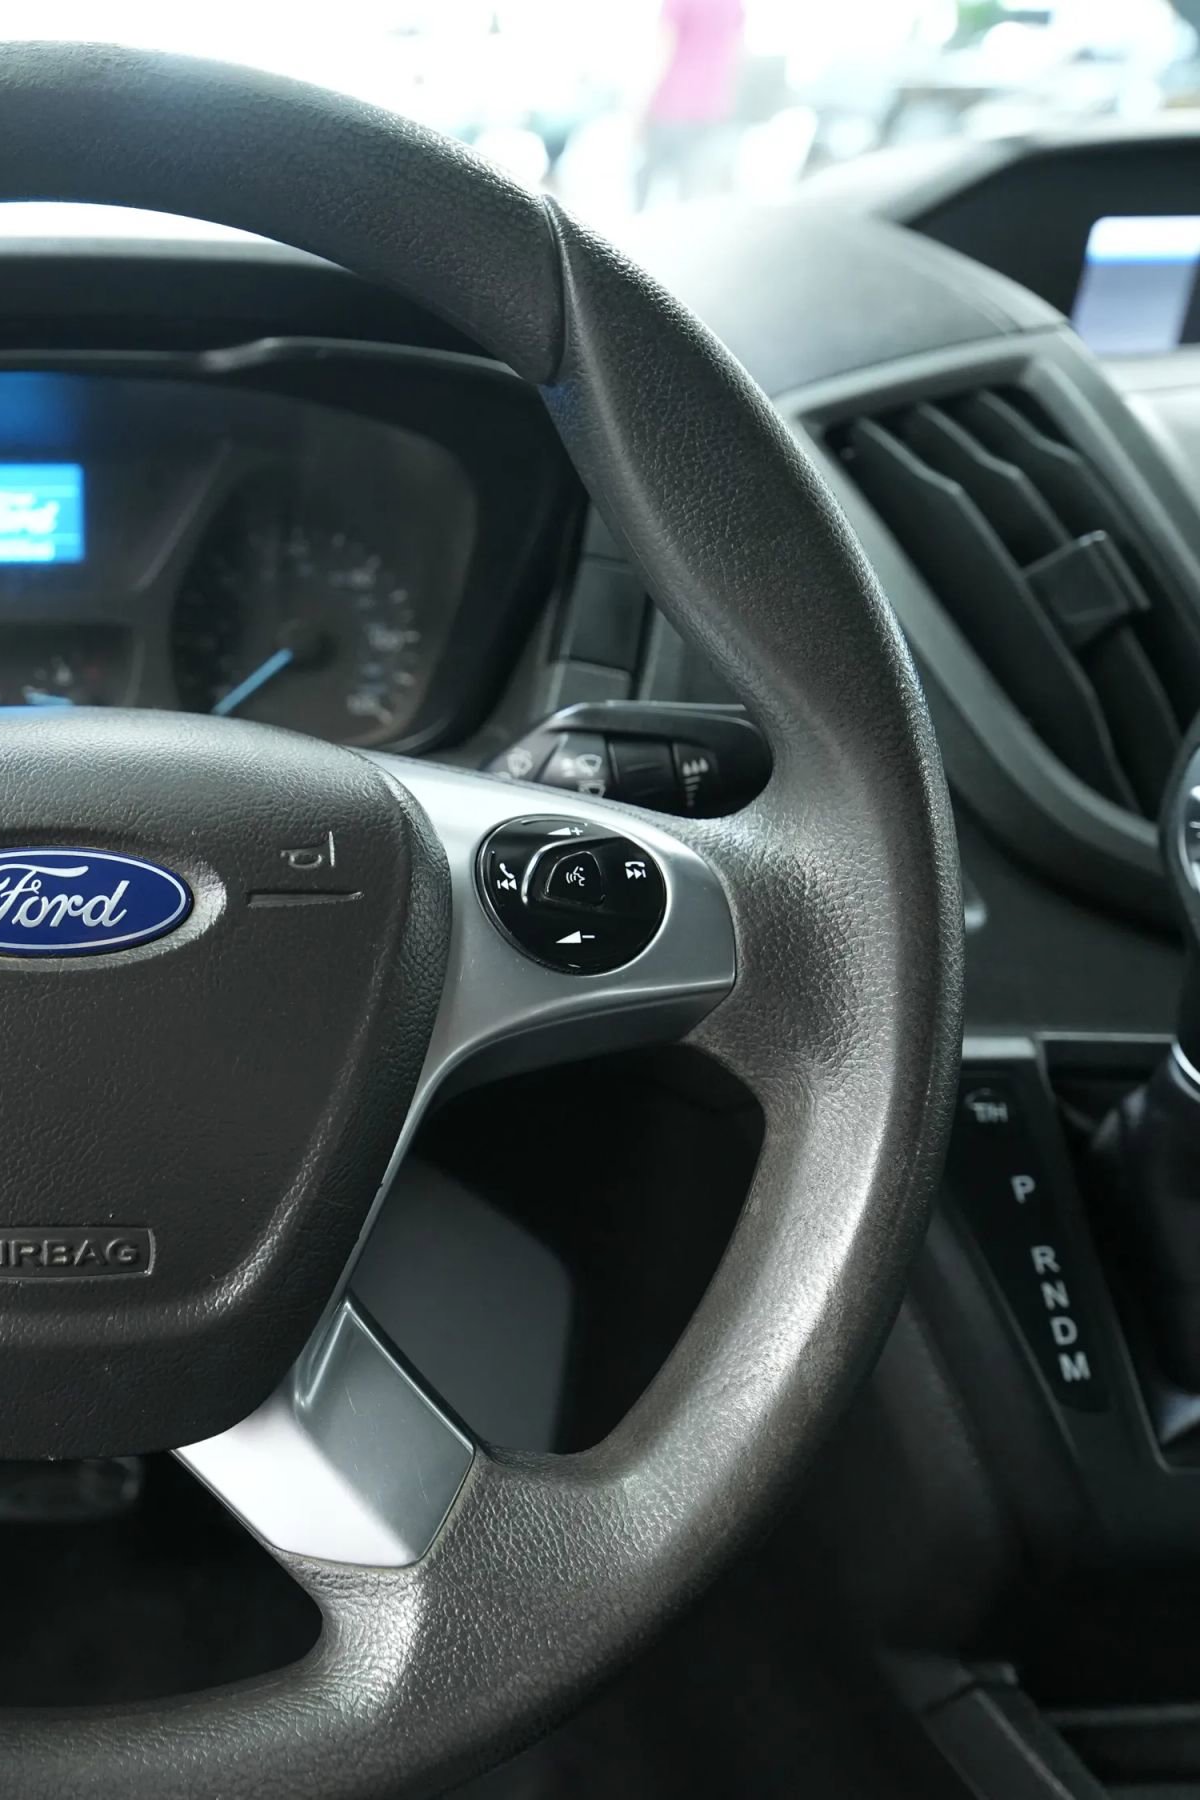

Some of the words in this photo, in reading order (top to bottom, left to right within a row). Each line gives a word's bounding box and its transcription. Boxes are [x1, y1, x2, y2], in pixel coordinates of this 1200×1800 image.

[1010, 1174, 1036, 1204] P
[1031, 1245, 1061, 1275] R
[1040, 1280, 1070, 1310] N
[1050, 1316, 1078, 1346] D
[1058, 1351, 1091, 1382] M
